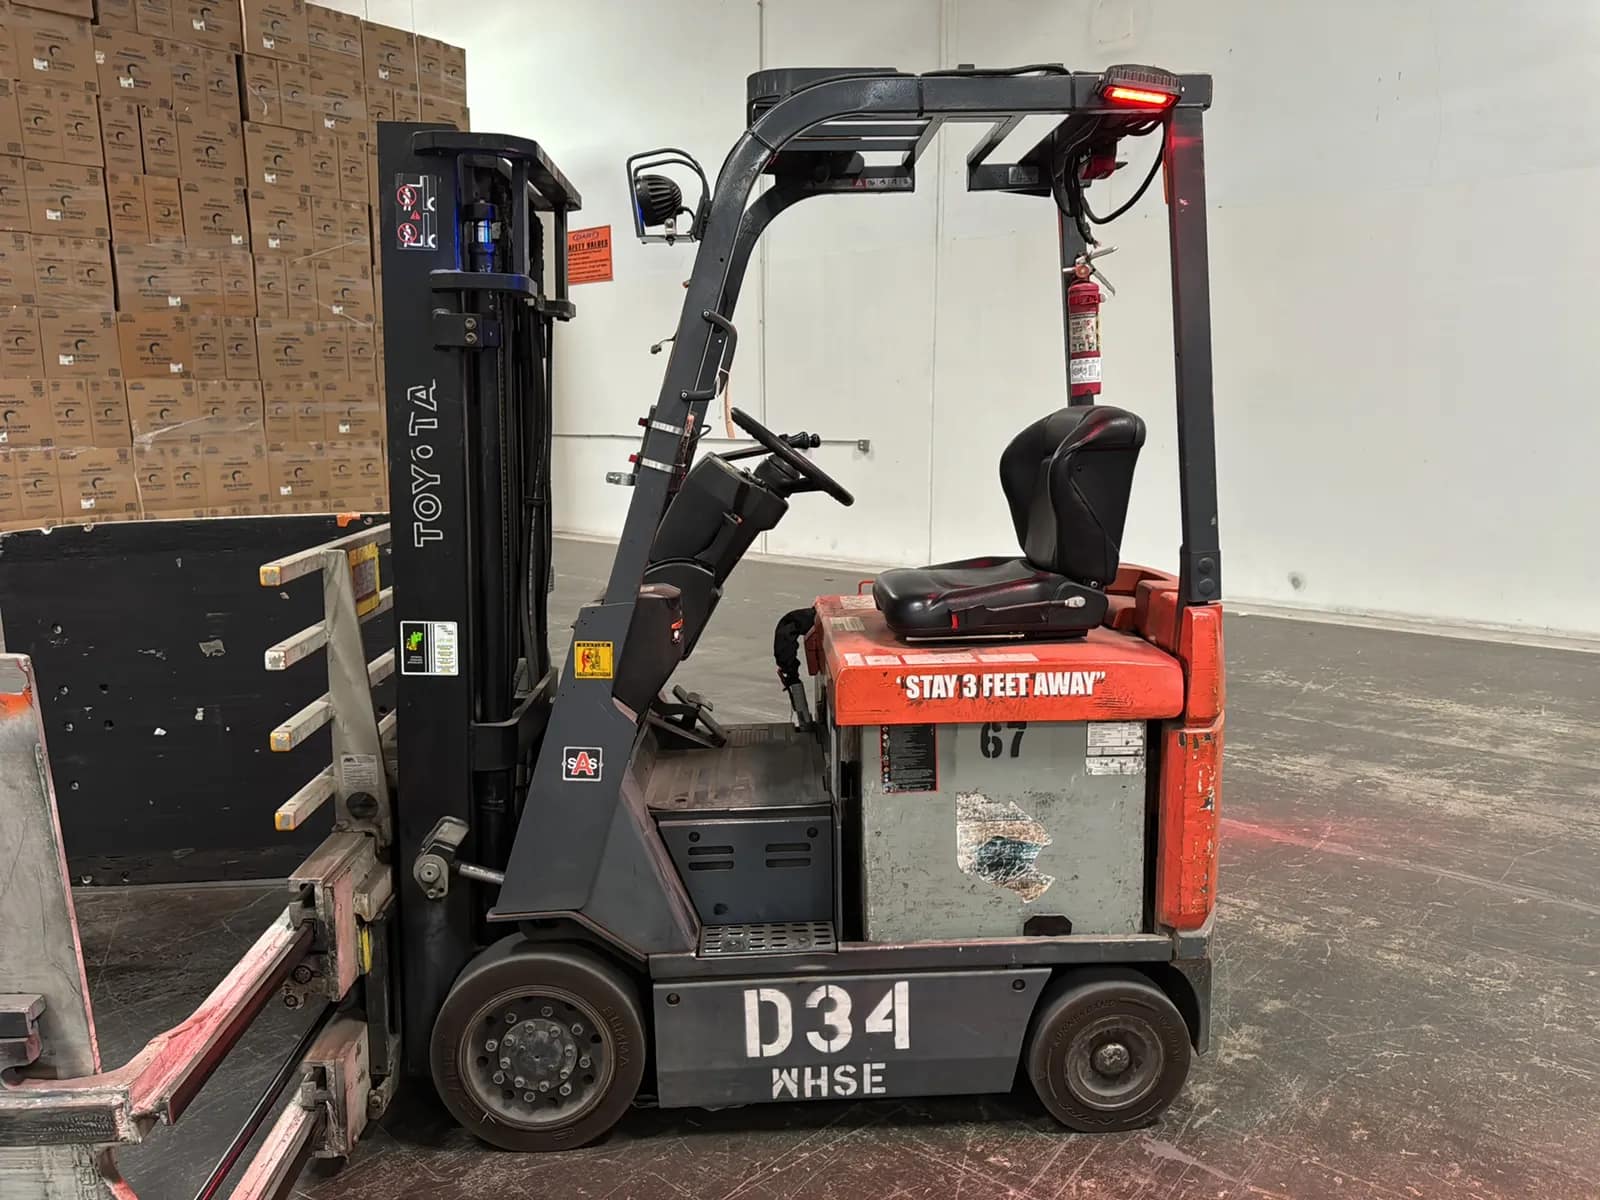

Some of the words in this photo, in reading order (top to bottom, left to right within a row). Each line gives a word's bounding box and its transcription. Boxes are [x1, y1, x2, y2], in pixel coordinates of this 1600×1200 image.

[568, 242, 585, 252] AFETY
[407, 378, 443, 547] TOYOTA
[962, 673, 977, 698] 3
[982, 672, 1029, 697] FEET
[980, 721, 1027, 759] 67
[744, 981, 910, 1058] D34
[771, 1063, 887, 1099] WHSE
